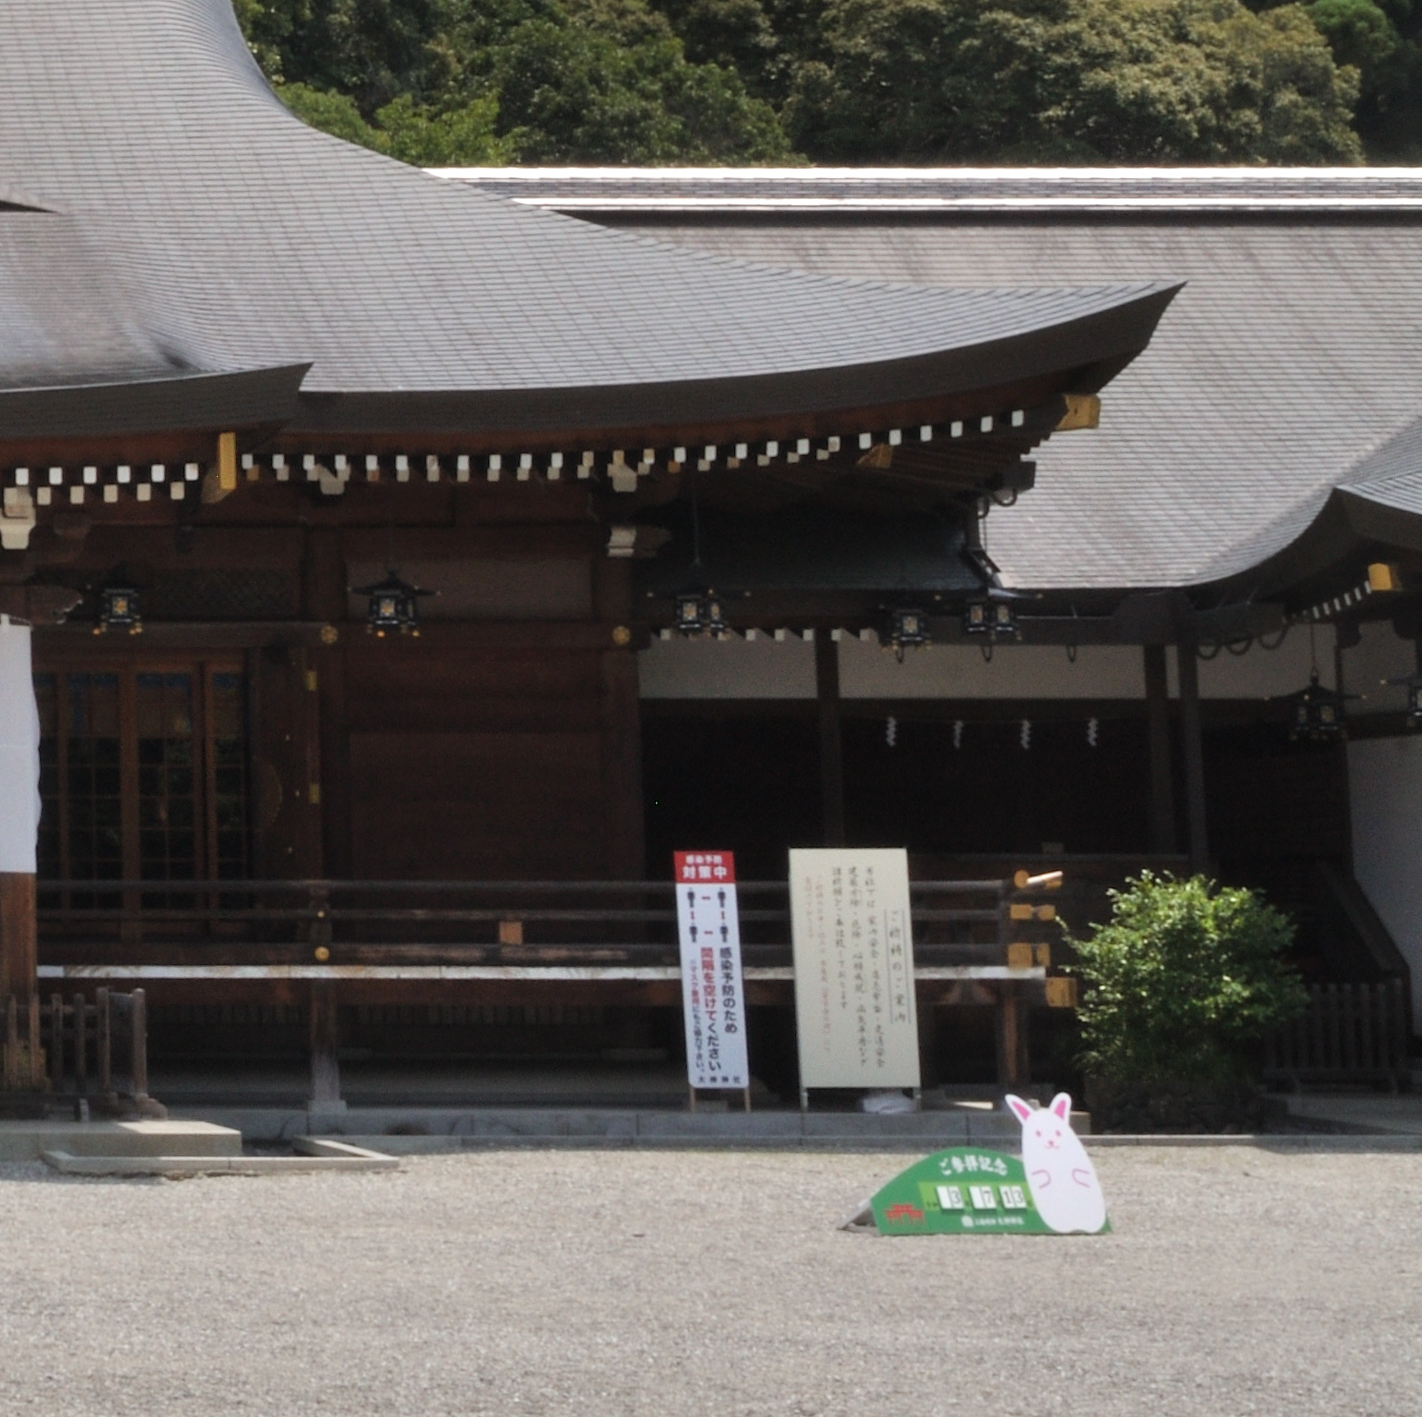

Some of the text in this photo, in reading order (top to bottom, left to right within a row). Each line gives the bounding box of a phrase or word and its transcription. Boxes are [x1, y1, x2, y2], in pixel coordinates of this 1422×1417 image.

[685, 854, 723, 864] 感染予防
[682, 865, 727, 880] 対策中
[719, 947, 738, 1034] 感染予防のため
[700, 947, 722, 1071] 間隔を空けてください
[938, 1154, 1008, 1177] ご参拝記念
[951, 1190, 960, 1204] 3
[983, 1190, 991, 1204] 7
[1003, 1190, 1023, 1204] 13
